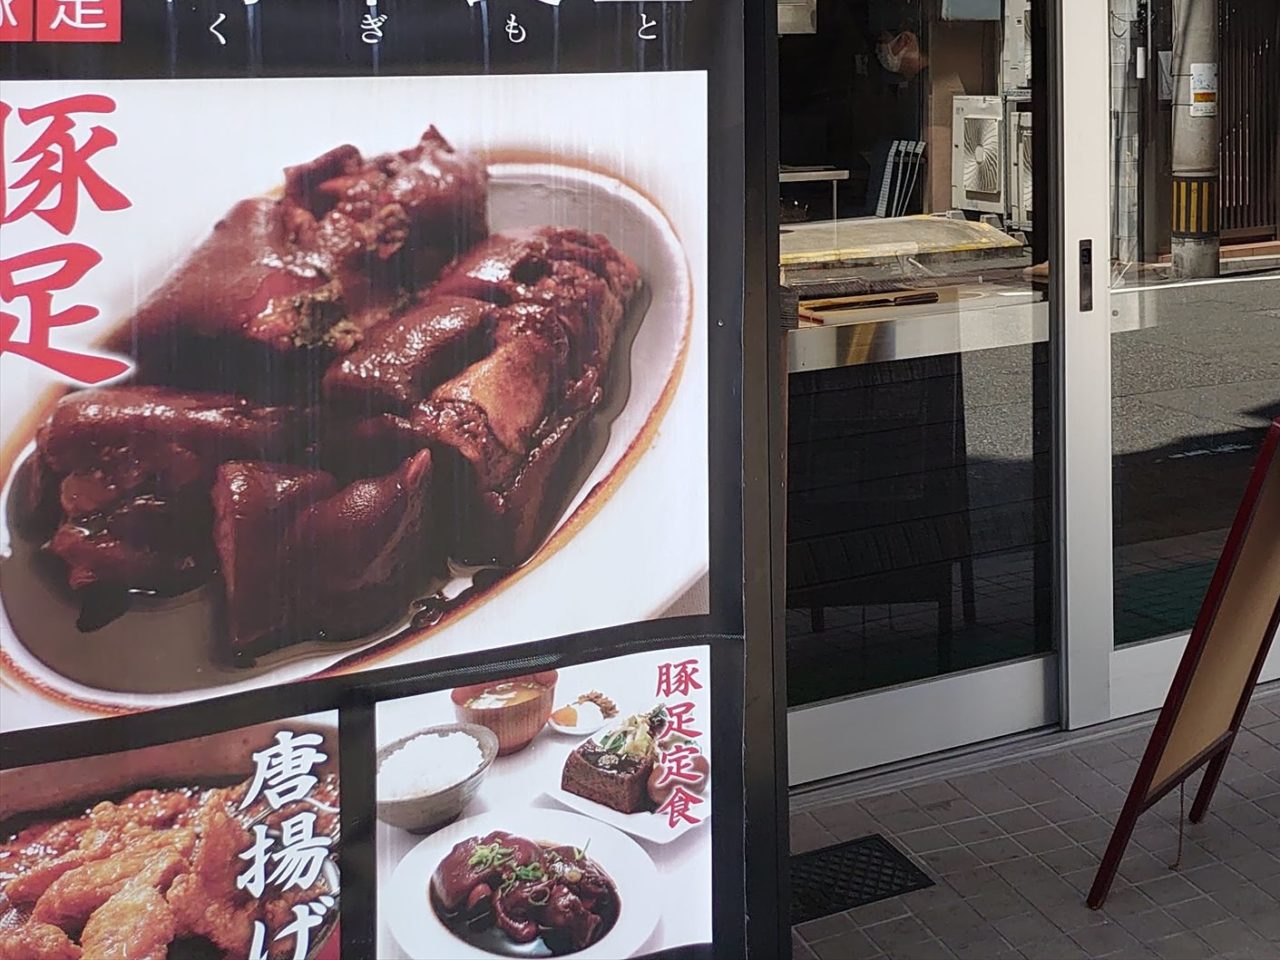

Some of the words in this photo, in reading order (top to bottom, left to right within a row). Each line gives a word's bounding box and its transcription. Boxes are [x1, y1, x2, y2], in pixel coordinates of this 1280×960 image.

[209, 12, 658, 44] くぎもと
[0, 94, 132, 383] 豚足
[655, 659, 704, 830] 豚足定食
[236, 731, 335, 960] 唐揚げ
